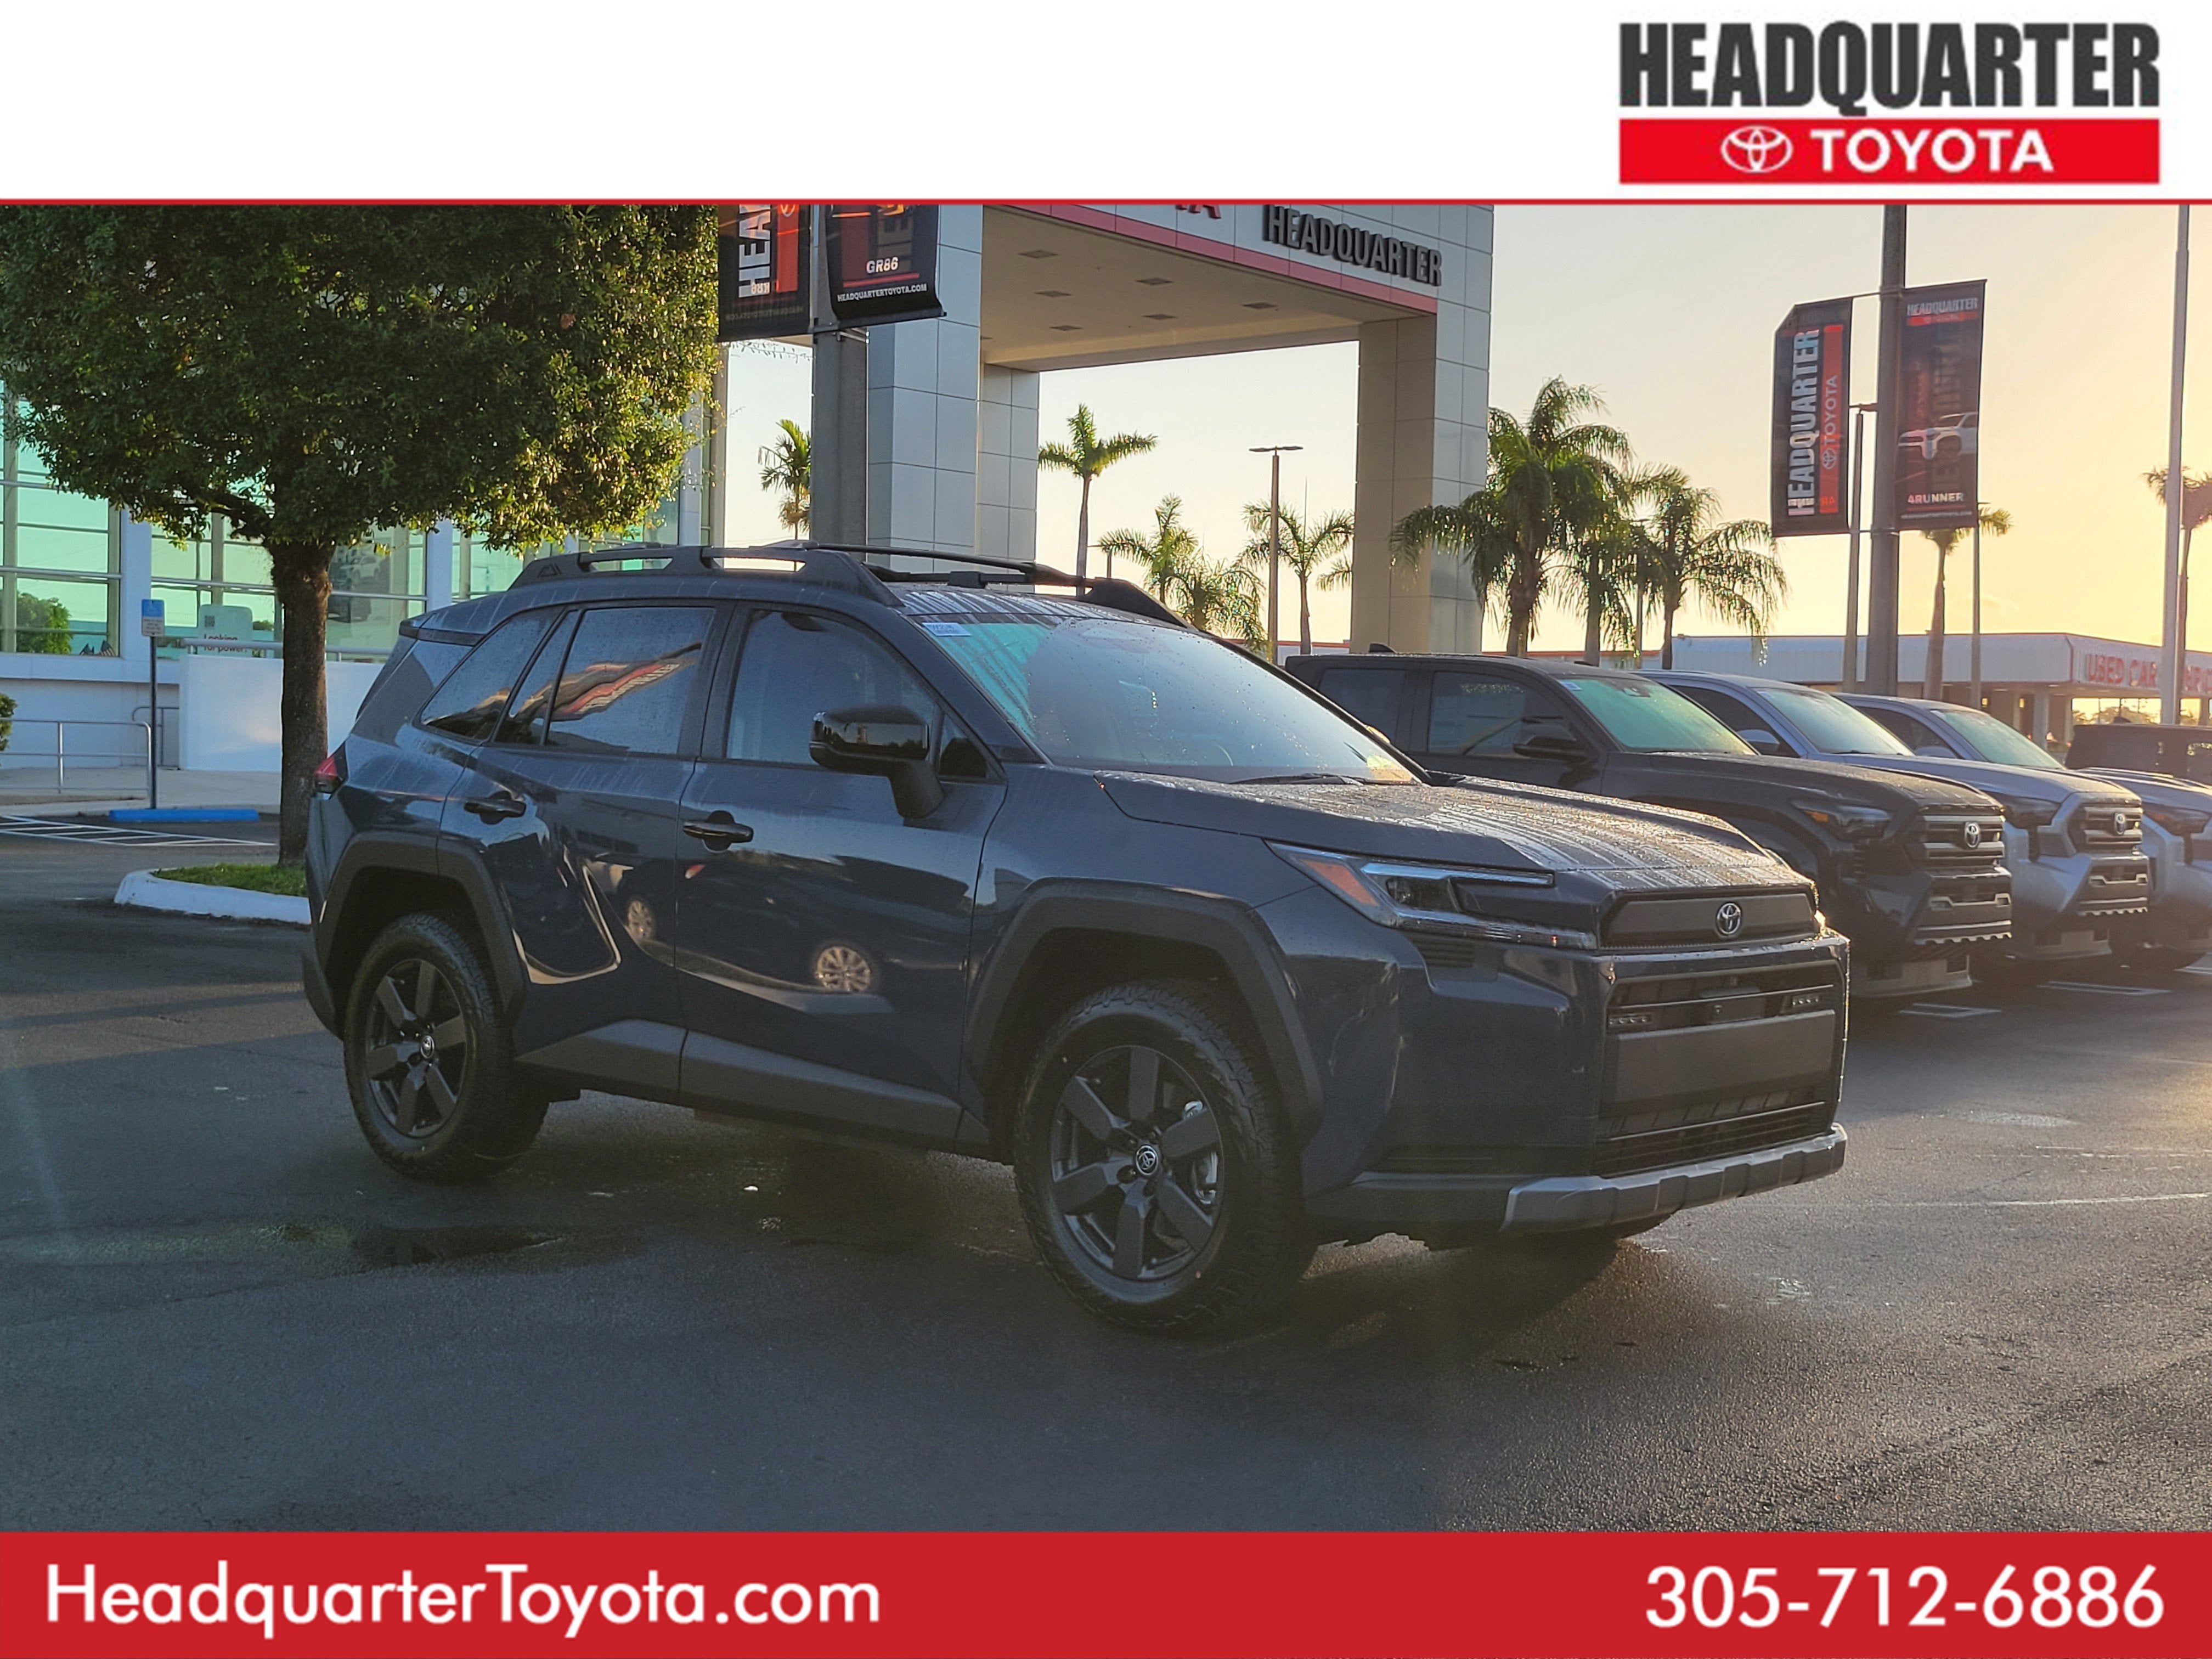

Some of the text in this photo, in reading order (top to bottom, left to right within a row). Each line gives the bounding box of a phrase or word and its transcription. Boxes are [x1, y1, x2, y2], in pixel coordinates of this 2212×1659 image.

[1263, 204, 1442, 286] HEADQUARTER
[866, 256, 899, 274] GR86
[837, 283, 927, 302] HEADQUARTERTOYOTA.COM
[1787, 329, 1820, 516] HEADQUARTER
[1823, 374, 1838, 446] TOYOTA
[1908, 492, 1964, 504] 4RUNNER
[2086, 653, 2125, 684] USED
